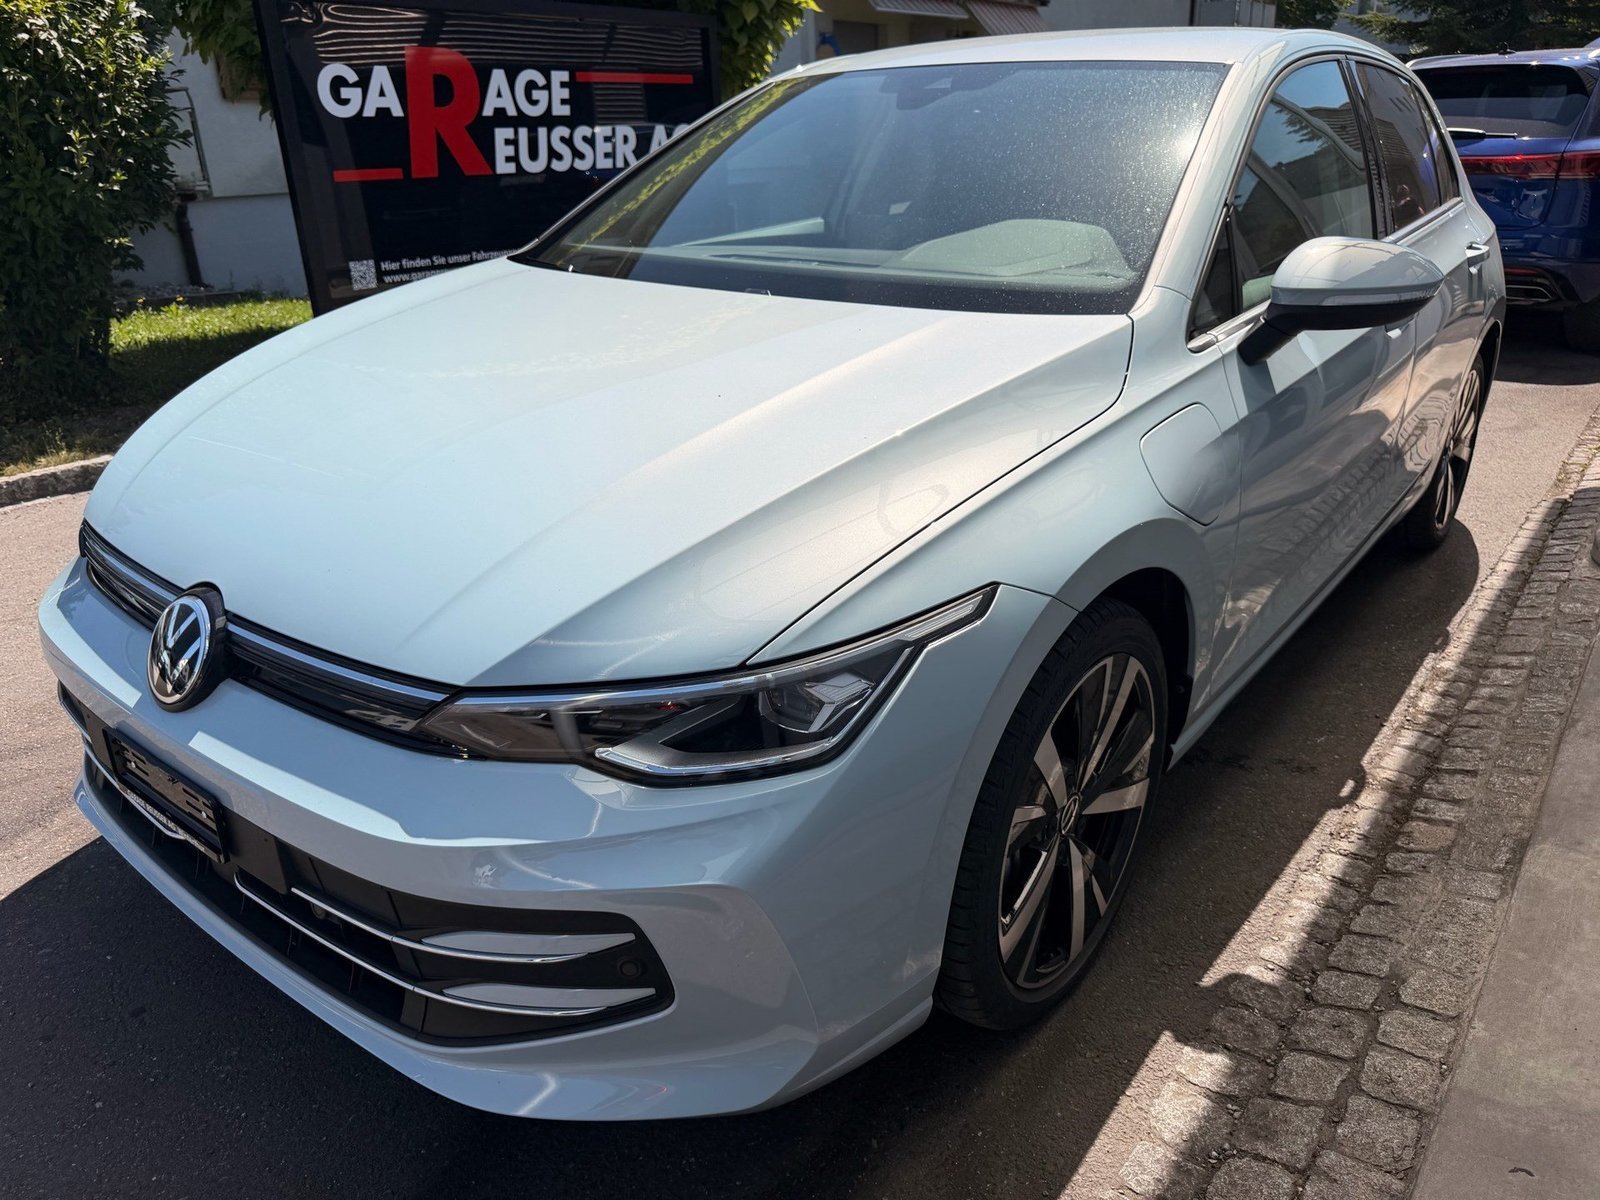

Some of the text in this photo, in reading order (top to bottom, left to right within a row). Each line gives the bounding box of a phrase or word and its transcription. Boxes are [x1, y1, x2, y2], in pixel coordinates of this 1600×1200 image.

[316, 46, 571, 179] GARAGE
[380, 260, 400, 271] Hier
[401, 257, 432, 269] finden
[432, 254, 447, 266] Sie
[447, 253, 471, 264] unser
